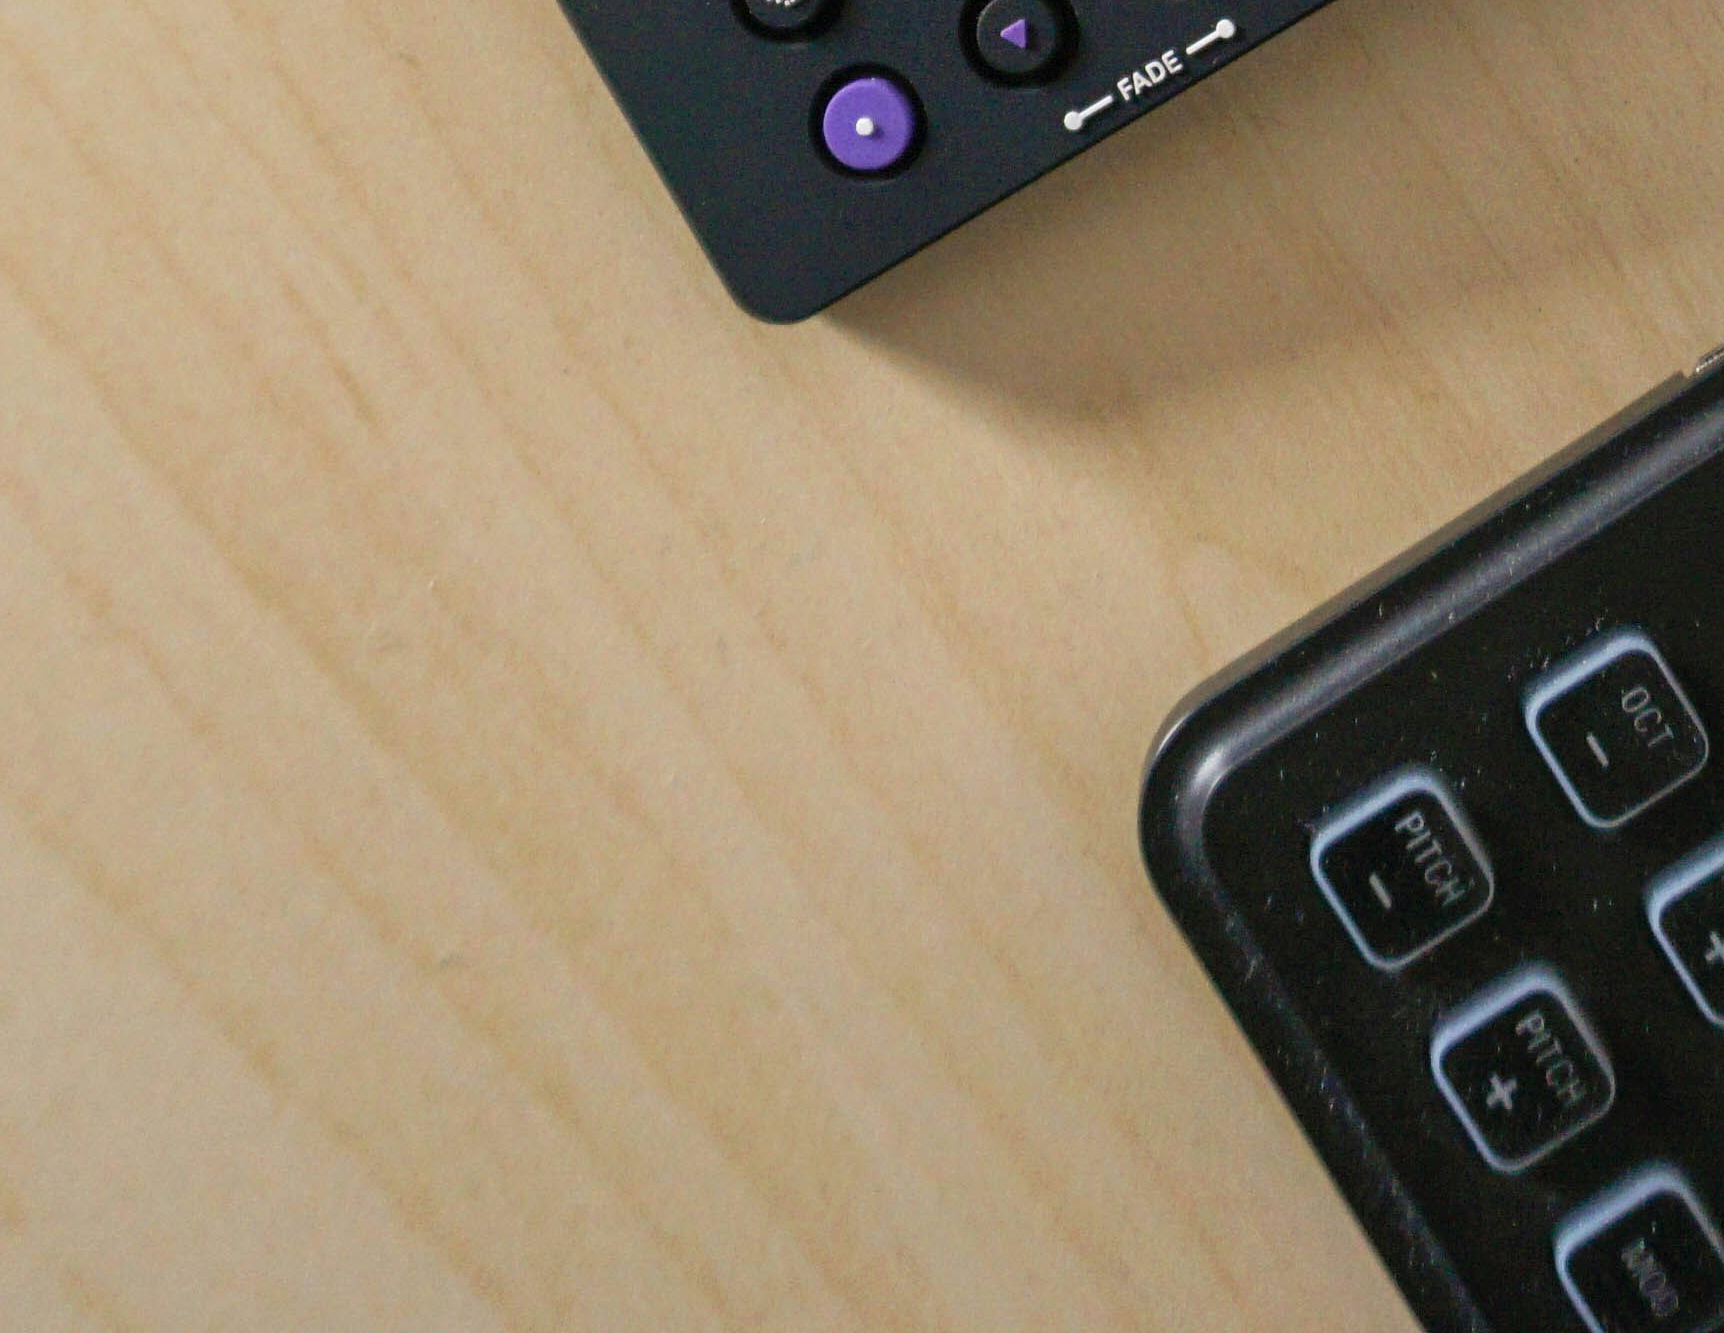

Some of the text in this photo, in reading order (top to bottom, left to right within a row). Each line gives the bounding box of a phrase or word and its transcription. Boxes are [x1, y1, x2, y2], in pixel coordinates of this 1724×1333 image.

[1116, 50, 1184, 103] FADE
[1622, 684, 1675, 748] OCT
[1394, 810, 1469, 908] PITCH
[1514, 1009, 1587, 1106] PITCH
